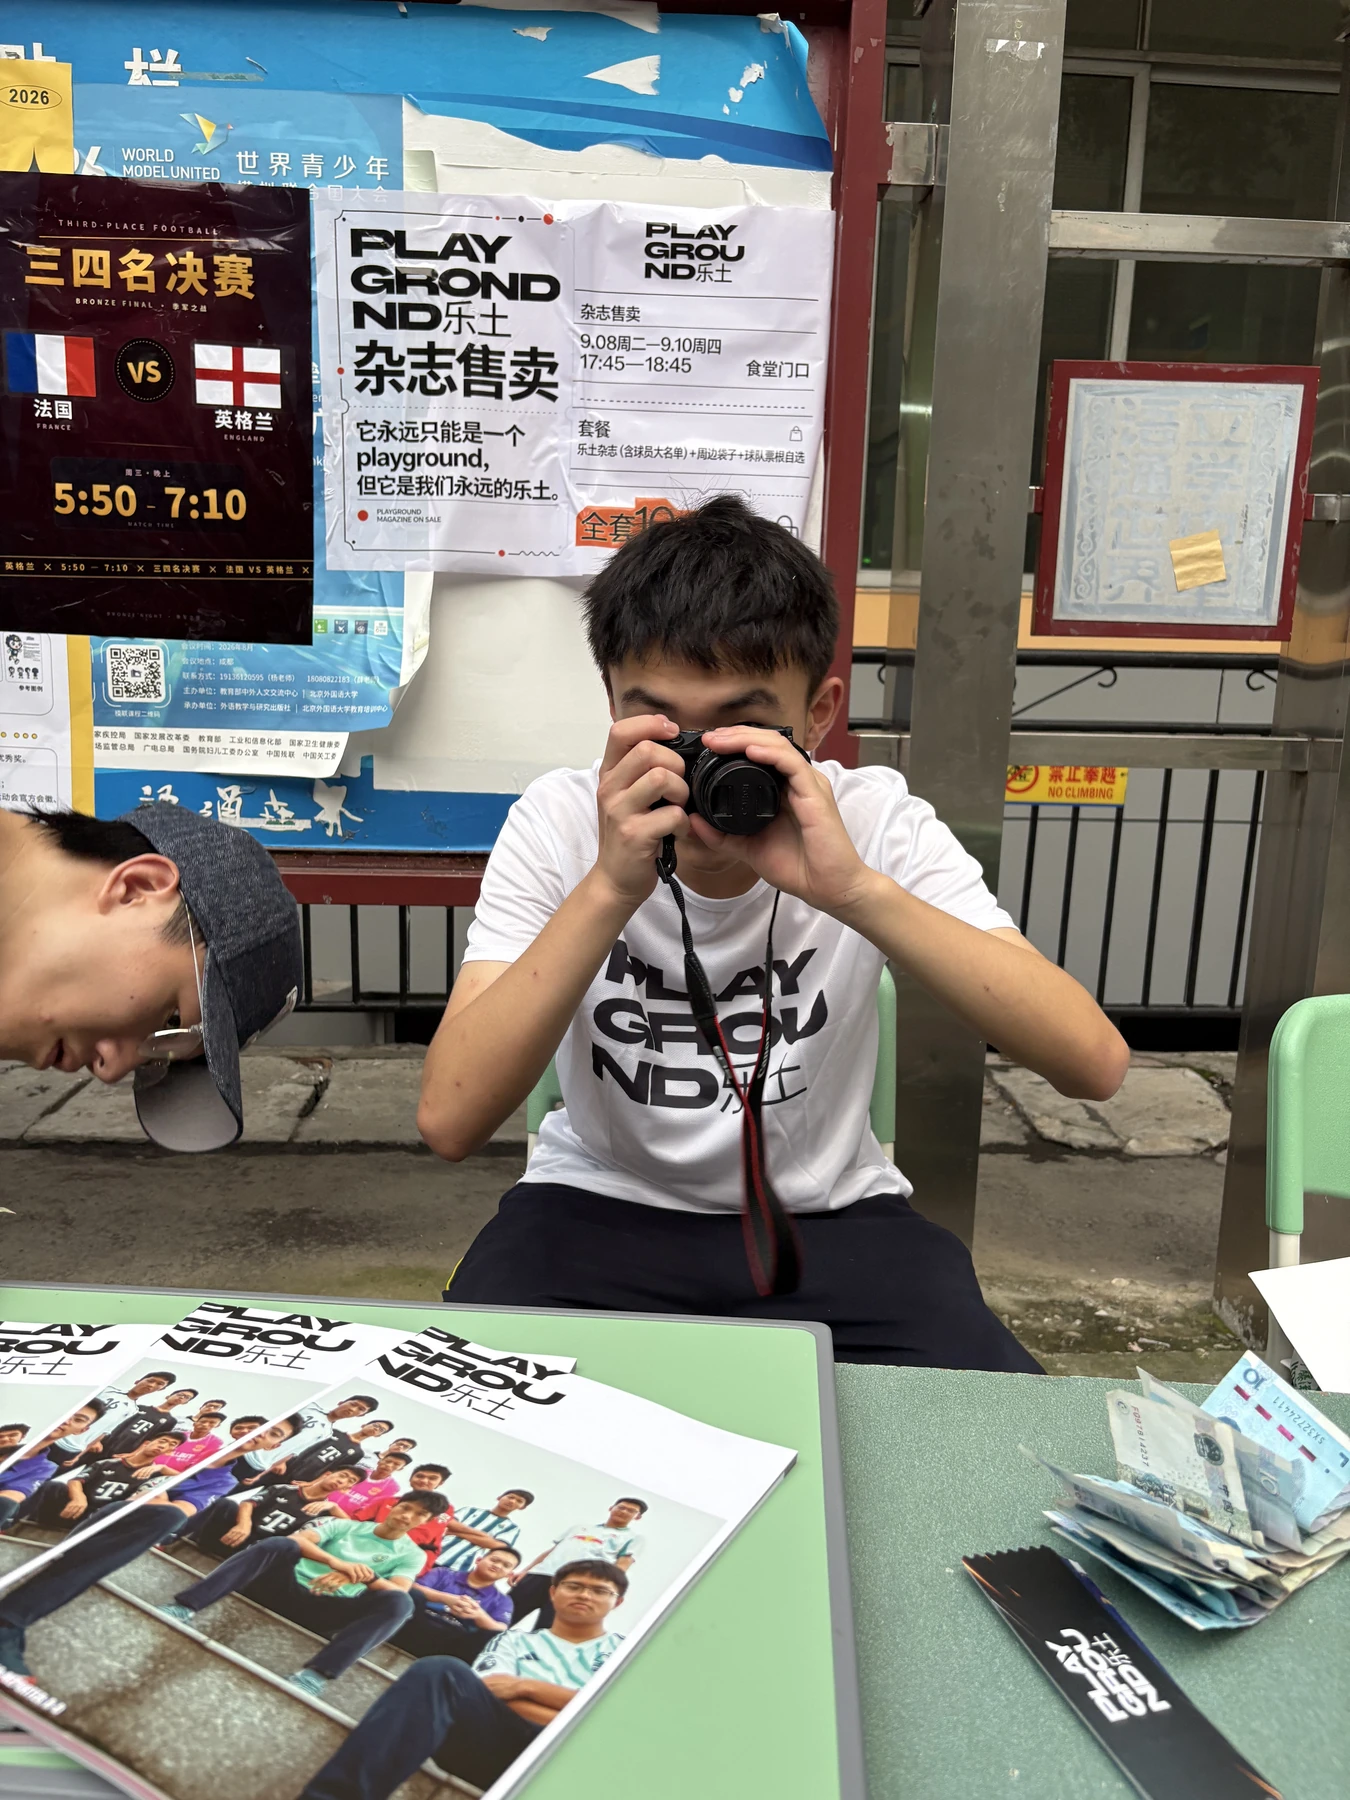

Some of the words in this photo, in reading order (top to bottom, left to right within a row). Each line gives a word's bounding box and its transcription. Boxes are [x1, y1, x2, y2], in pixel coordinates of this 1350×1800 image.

[9, 88, 50, 105] 2026
[122, 147, 174, 163] WORLD
[236, 150, 390, 181] 世界青少年
[58, 219, 146, 231] THIRD-PLACE
[153, 223, 219, 236] FOOTBALL
[645, 222, 738, 241] PLAY
[350, 228, 513, 265] PLAY
[644, 241, 745, 262] GROU
[24, 247, 256, 300] 三四名决赛
[350, 264, 561, 303] GROND
[644, 263, 733, 284] ND乐土
[75, 298, 117, 307] BRONZE
[122, 300, 153, 309] FINAL
[580, 303, 641, 323] 杂志售卖
[352, 300, 512, 338] ND乐土
[126, 360, 162, 384] VS
[353, 339, 560, 404] 杂志售卖
[746, 359, 810, 379] 食堂门口
[33, 398, 73, 420] 法国
[36, 422, 72, 431] FRANCE
[214, 409, 274, 432] 英格兰
[578, 419, 611, 439] 套餐
[223, 434, 266, 443] ENGLAND
[356, 419, 526, 448] 它永远只能是一个
[356, 446, 490, 473] playground,
[356, 475, 559, 501] 但它是我们永远的乐土。
[54, 482, 137, 517] 5:50
[164, 486, 247, 521] 7:10
[376, 508, 422, 517] PLAYGROUND
[425, 516, 442, 524] SALE
[5, 561, 35, 571] 英格兰
[61, 563, 86, 571] 5:50
[104, 563, 128, 572] 7:10
[153, 564, 201, 574] 三四名决赛
[225, 565, 244, 575] 法国
[249, 566, 262, 574] VS
[266, 565, 294, 575] 英格兰
[18, 685, 43, 693] 参考图例
[309, 690, 359, 699] 北京外国语大学
[134, 732, 190, 742] 国家发展改革委
[198, 734, 222, 743] 教育部
[229, 736, 282, 746] 工业和信息化部
[289, 739, 341, 749] 国家卫生健康委
[0, 754, 26, 763] 秀奖。
[143, 744, 175, 753] 广电总局
[183, 745, 259, 757] 国务院妇儿工委办公室
[266, 750, 296, 759] 中国残联
[302, 751, 337, 760] 中国关工委
[1048, 786, 1063, 798] NO
[1065, 787, 1113, 799] CLIMBING
[1045, 1640, 1129, 1723] PLAY
[1059, 1628, 1148, 1717] GROU
